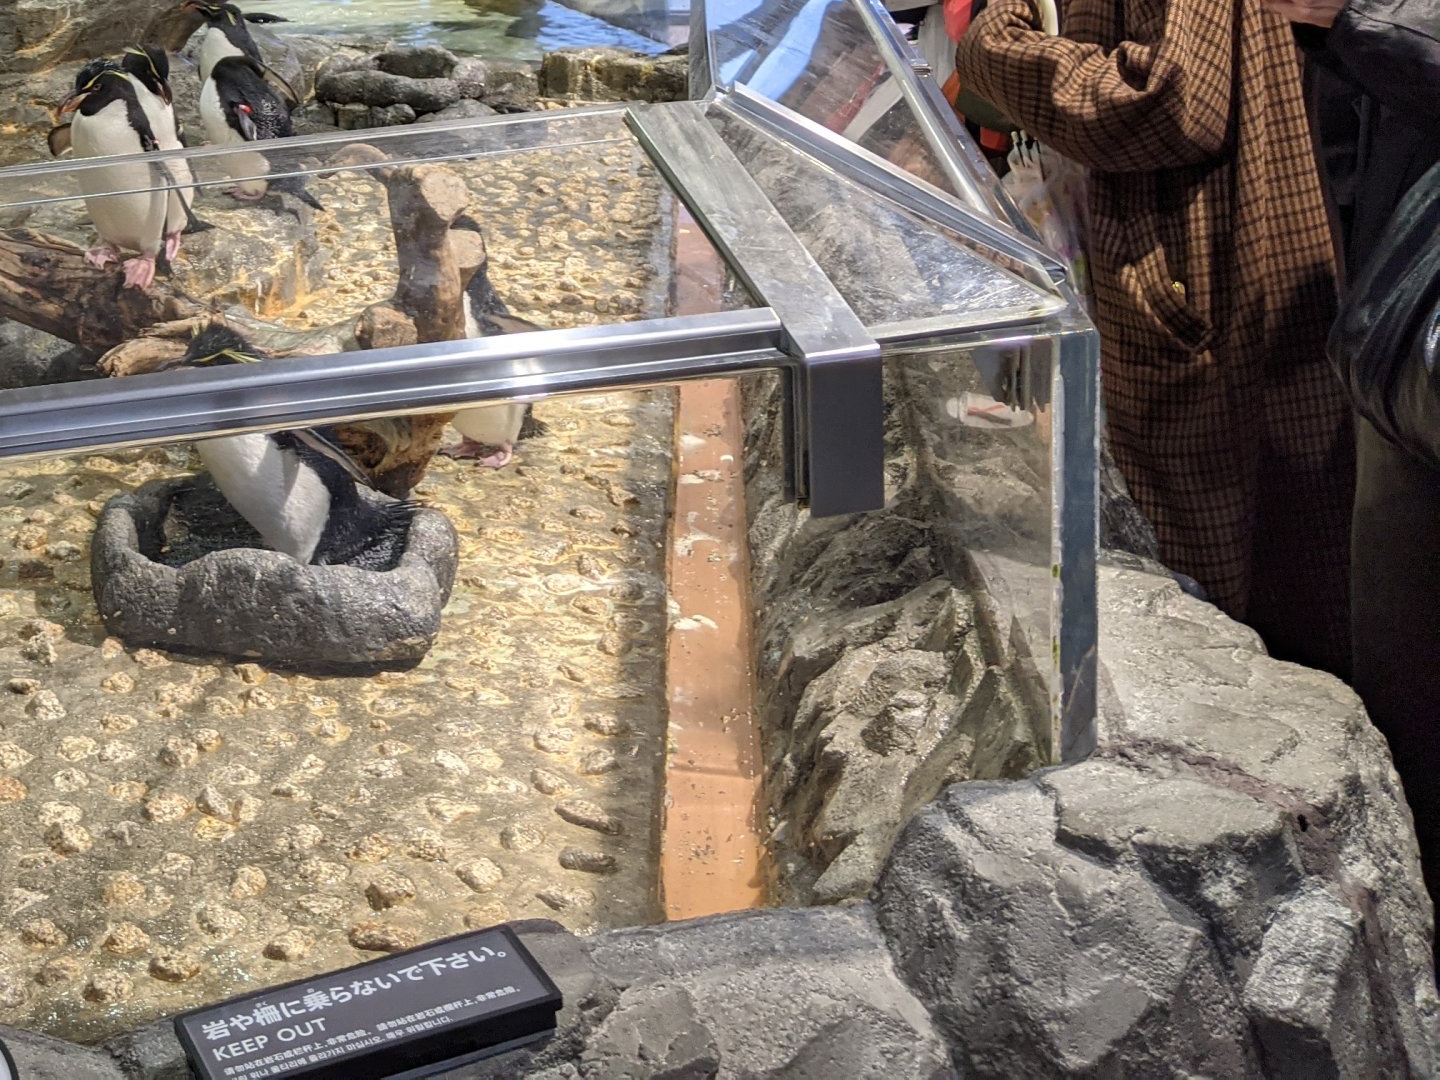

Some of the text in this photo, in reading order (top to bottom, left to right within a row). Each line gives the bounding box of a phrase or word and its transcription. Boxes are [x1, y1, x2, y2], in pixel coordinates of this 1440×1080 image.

[202, 946, 506, 1040] 岩や柵に乗らないで下さい。
[212, 1017, 326, 1061] KEEP OUT
